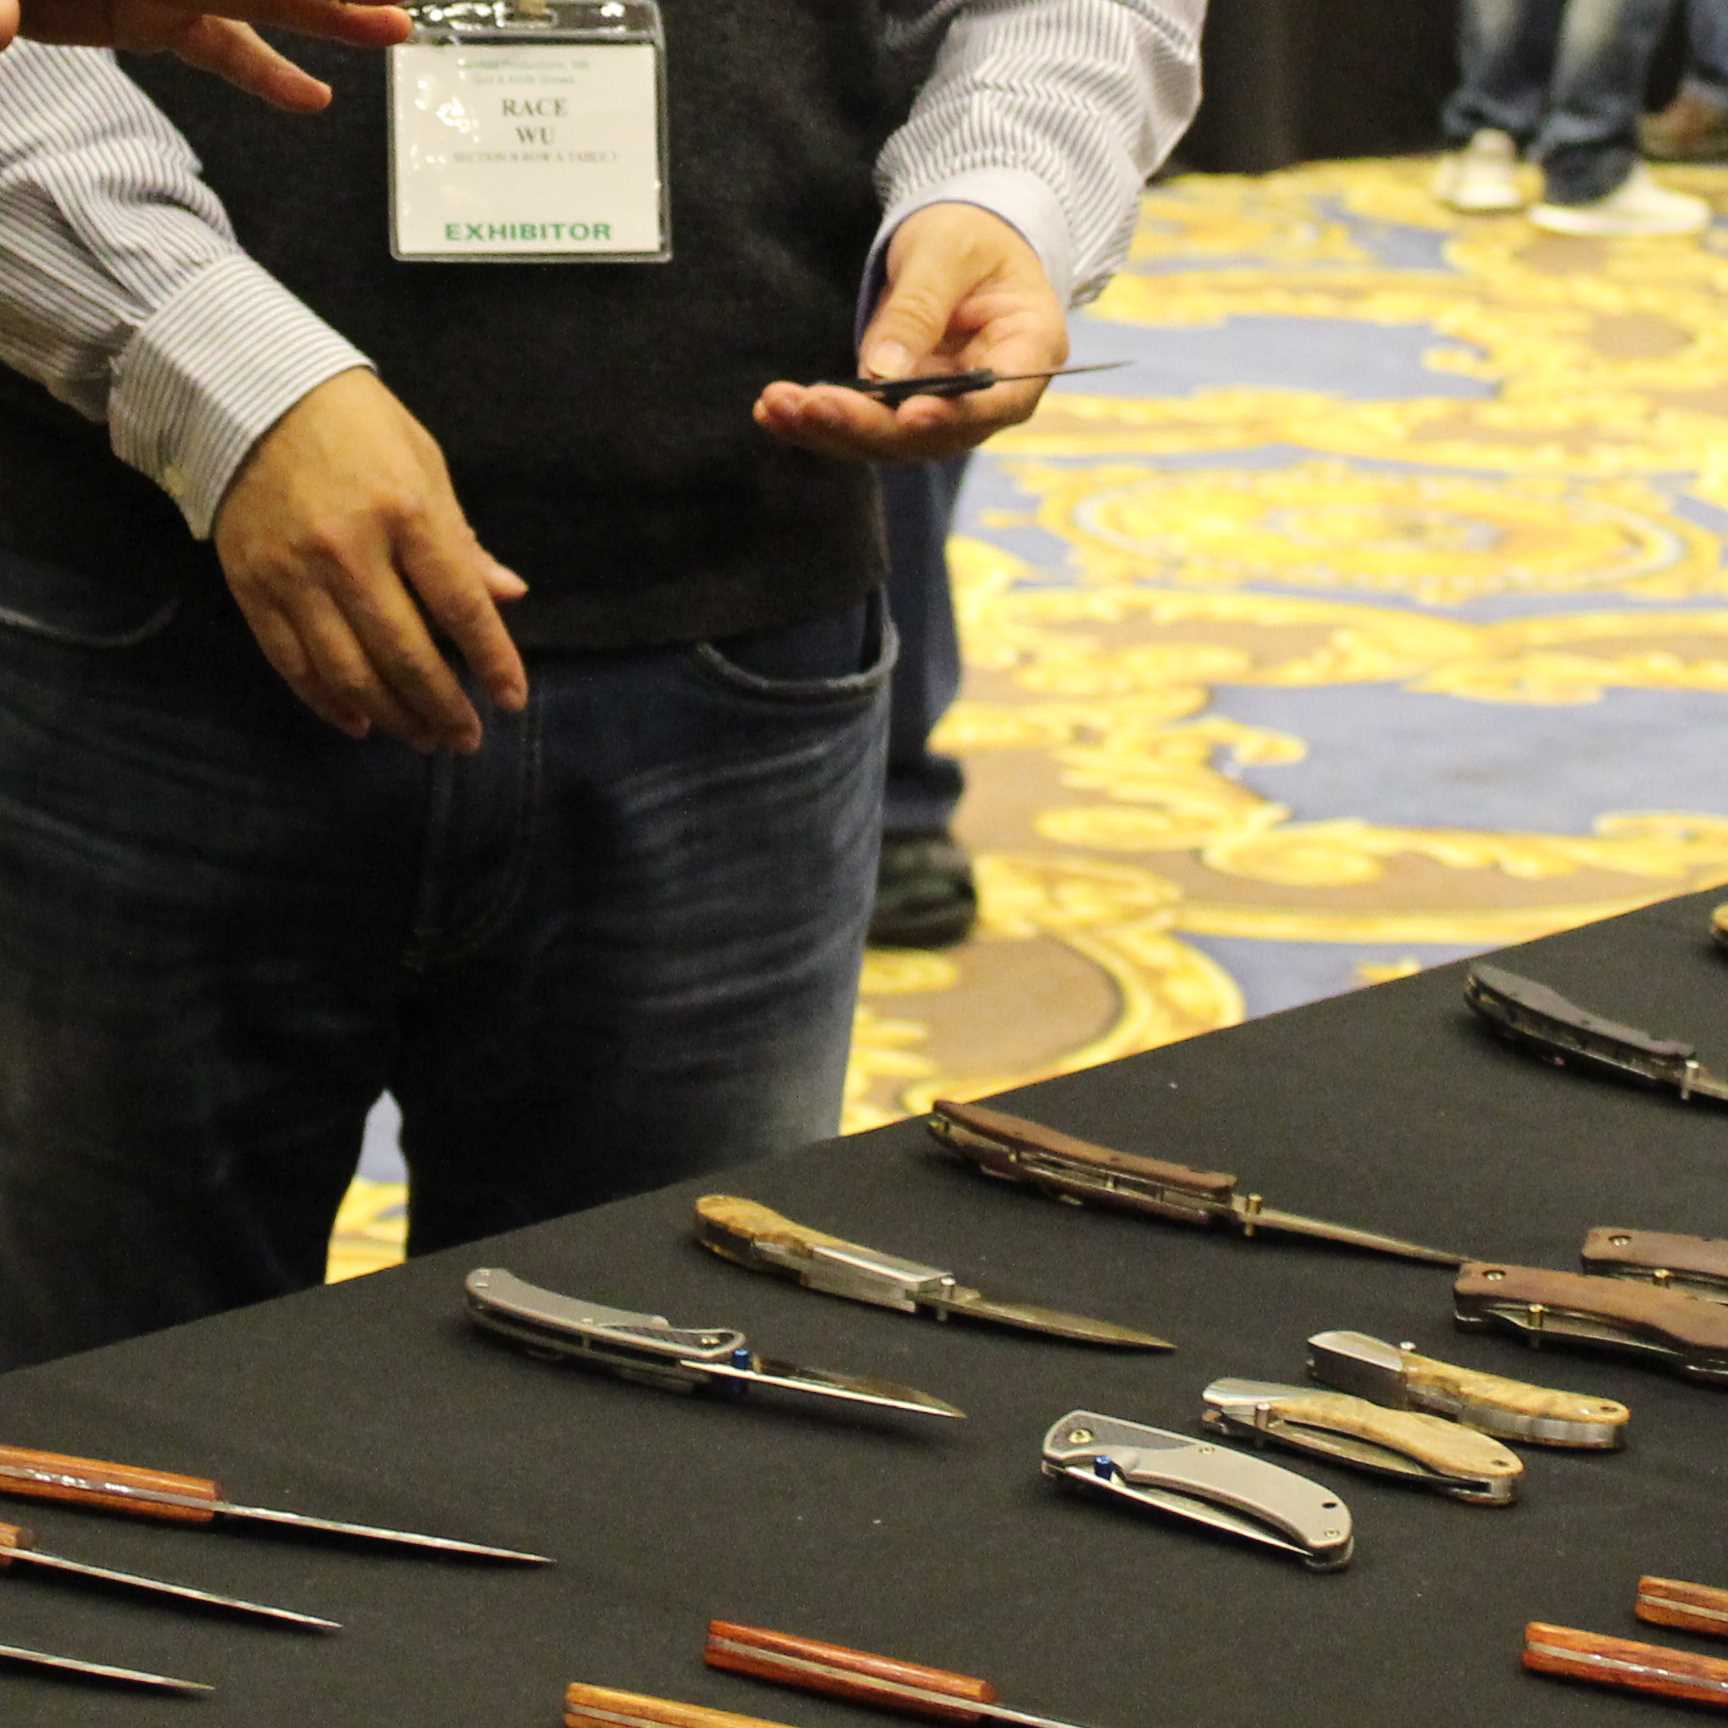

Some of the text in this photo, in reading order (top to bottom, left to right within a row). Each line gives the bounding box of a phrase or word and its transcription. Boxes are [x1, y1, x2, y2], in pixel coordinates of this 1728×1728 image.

[502, 97, 568, 117] RACE
[515, 126, 557, 145] WU
[444, 222, 612, 241] EXHIBITOR
